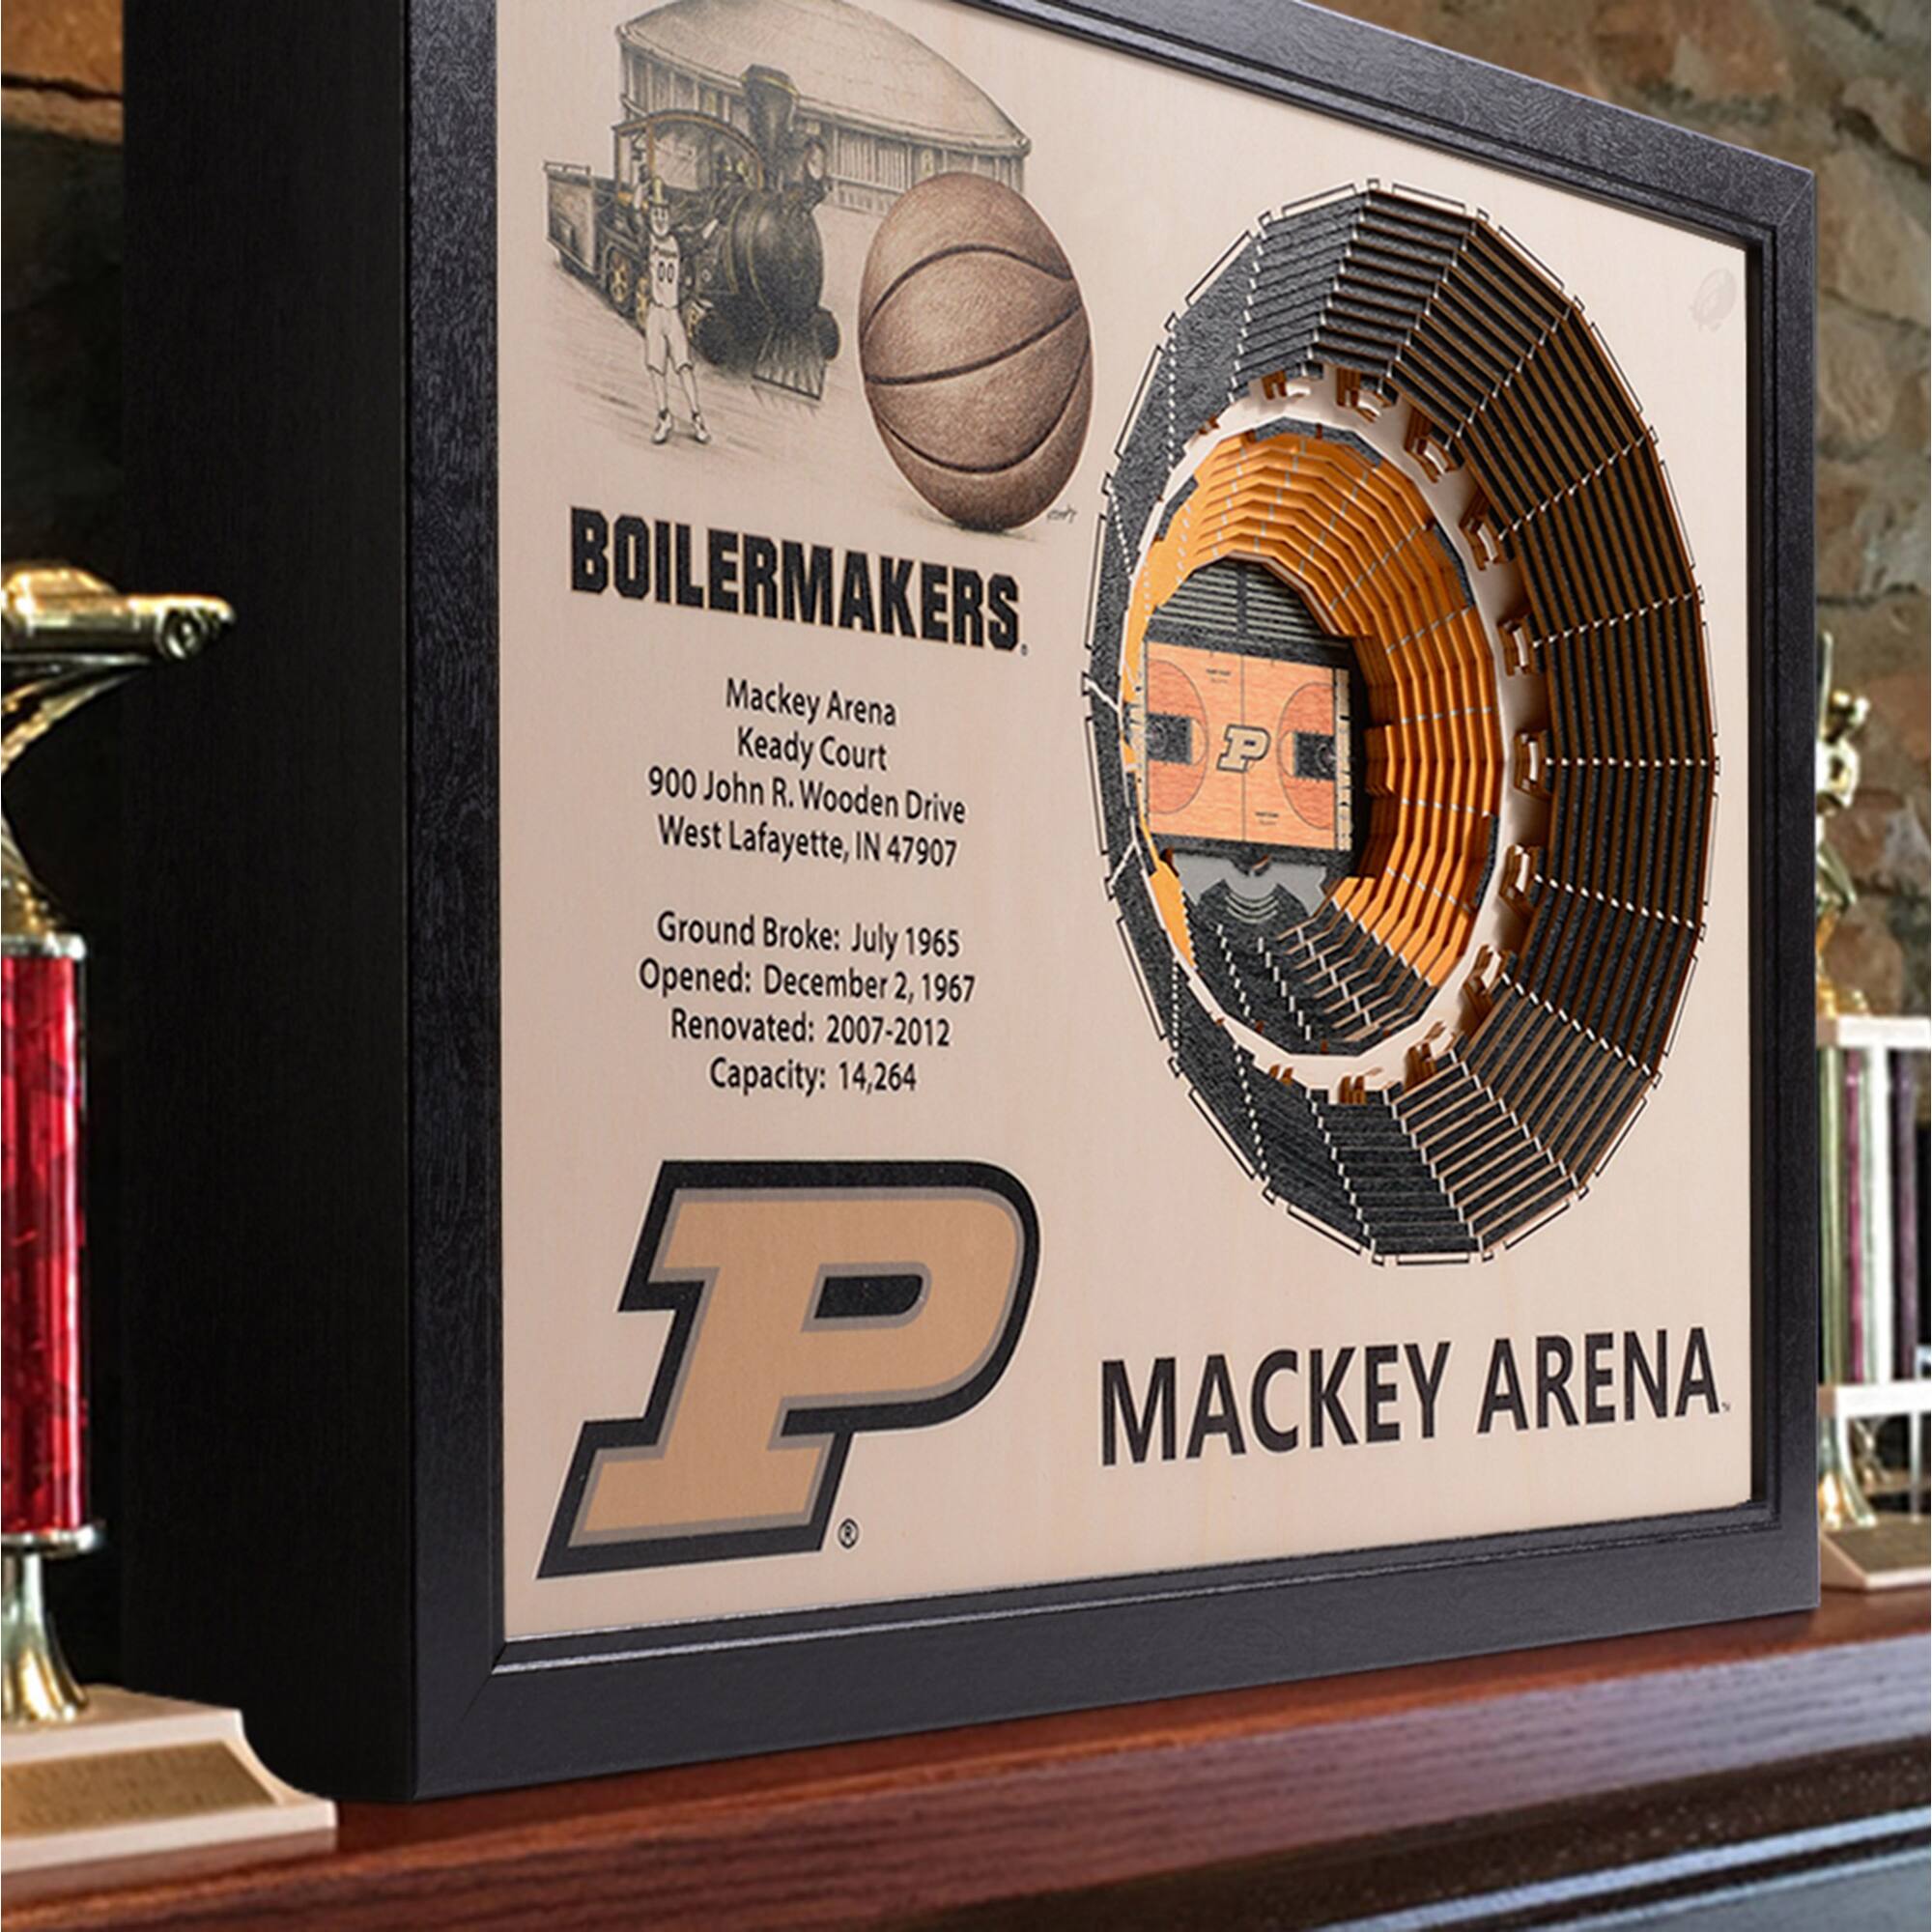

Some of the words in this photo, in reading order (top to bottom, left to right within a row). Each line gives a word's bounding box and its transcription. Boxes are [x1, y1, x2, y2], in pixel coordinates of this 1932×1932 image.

[570, 505, 1020, 653] BOILERMAKERS
[725, 676, 821, 725] Mackey
[826, 690, 896, 727] Arena
[737, 725, 815, 772] Keady
[819, 734, 888, 772] Court
[648, 765, 697, 800] 900
[702, 770, 765, 807] John
[772, 776, 794, 809] R.
[798, 779, 899, 818] Wooden
[905, 788, 966, 825] Drive
[657, 813, 723, 850] West
[728, 819, 850, 865] Lafayette,
[856, 830, 881, 862] IN
[886, 835, 957, 867] 47907
[657, 909, 755, 947] Ground
[762, 916, 840, 952] Broke:
[850, 922, 899, 962] July
[905, 926, 960, 958] 1965
[639, 956, 752, 999] Opened:
[763, 963, 889, 1000] December
[894, 970, 915, 1005] 2,
[922, 972, 976, 1004] 1967
[670, 1007, 814, 1043] Renovated:
[826, 1013, 950, 1047] 2007-2012
[709, 1056, 826, 1098] Capacity:
[838, 1061, 917, 1095] 14,264
[536, 1159, 1041, 1579] P
[1101, 1341, 1451, 1466] MACKEY
[1477, 1326, 1719, 1434] ARENA
